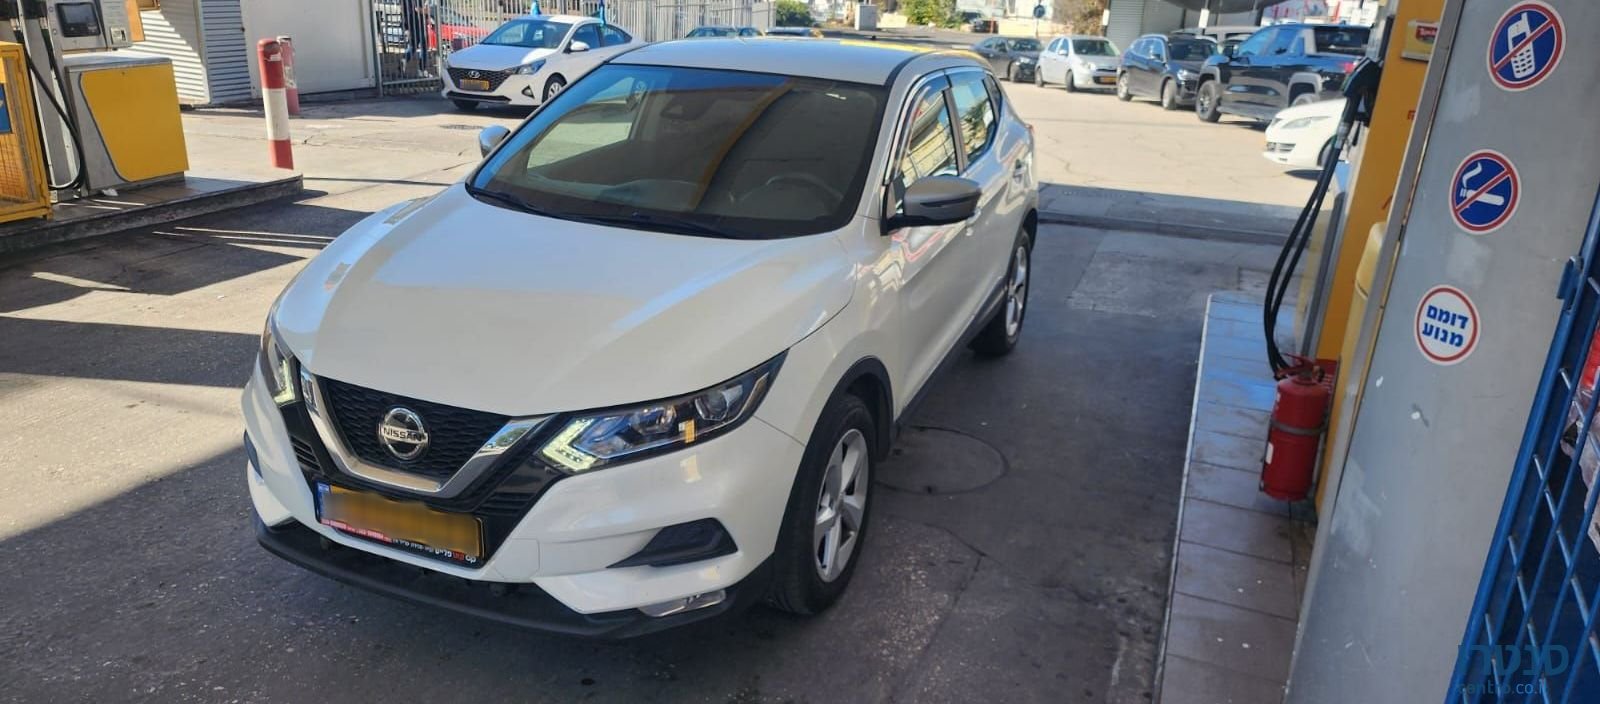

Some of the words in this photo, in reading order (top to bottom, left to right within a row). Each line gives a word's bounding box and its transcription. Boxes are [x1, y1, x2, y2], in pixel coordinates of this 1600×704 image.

[1426, 304, 1469, 329] דומם
[1422, 322, 1464, 347] מנוע
[384, 427, 426, 441] NISSAN
